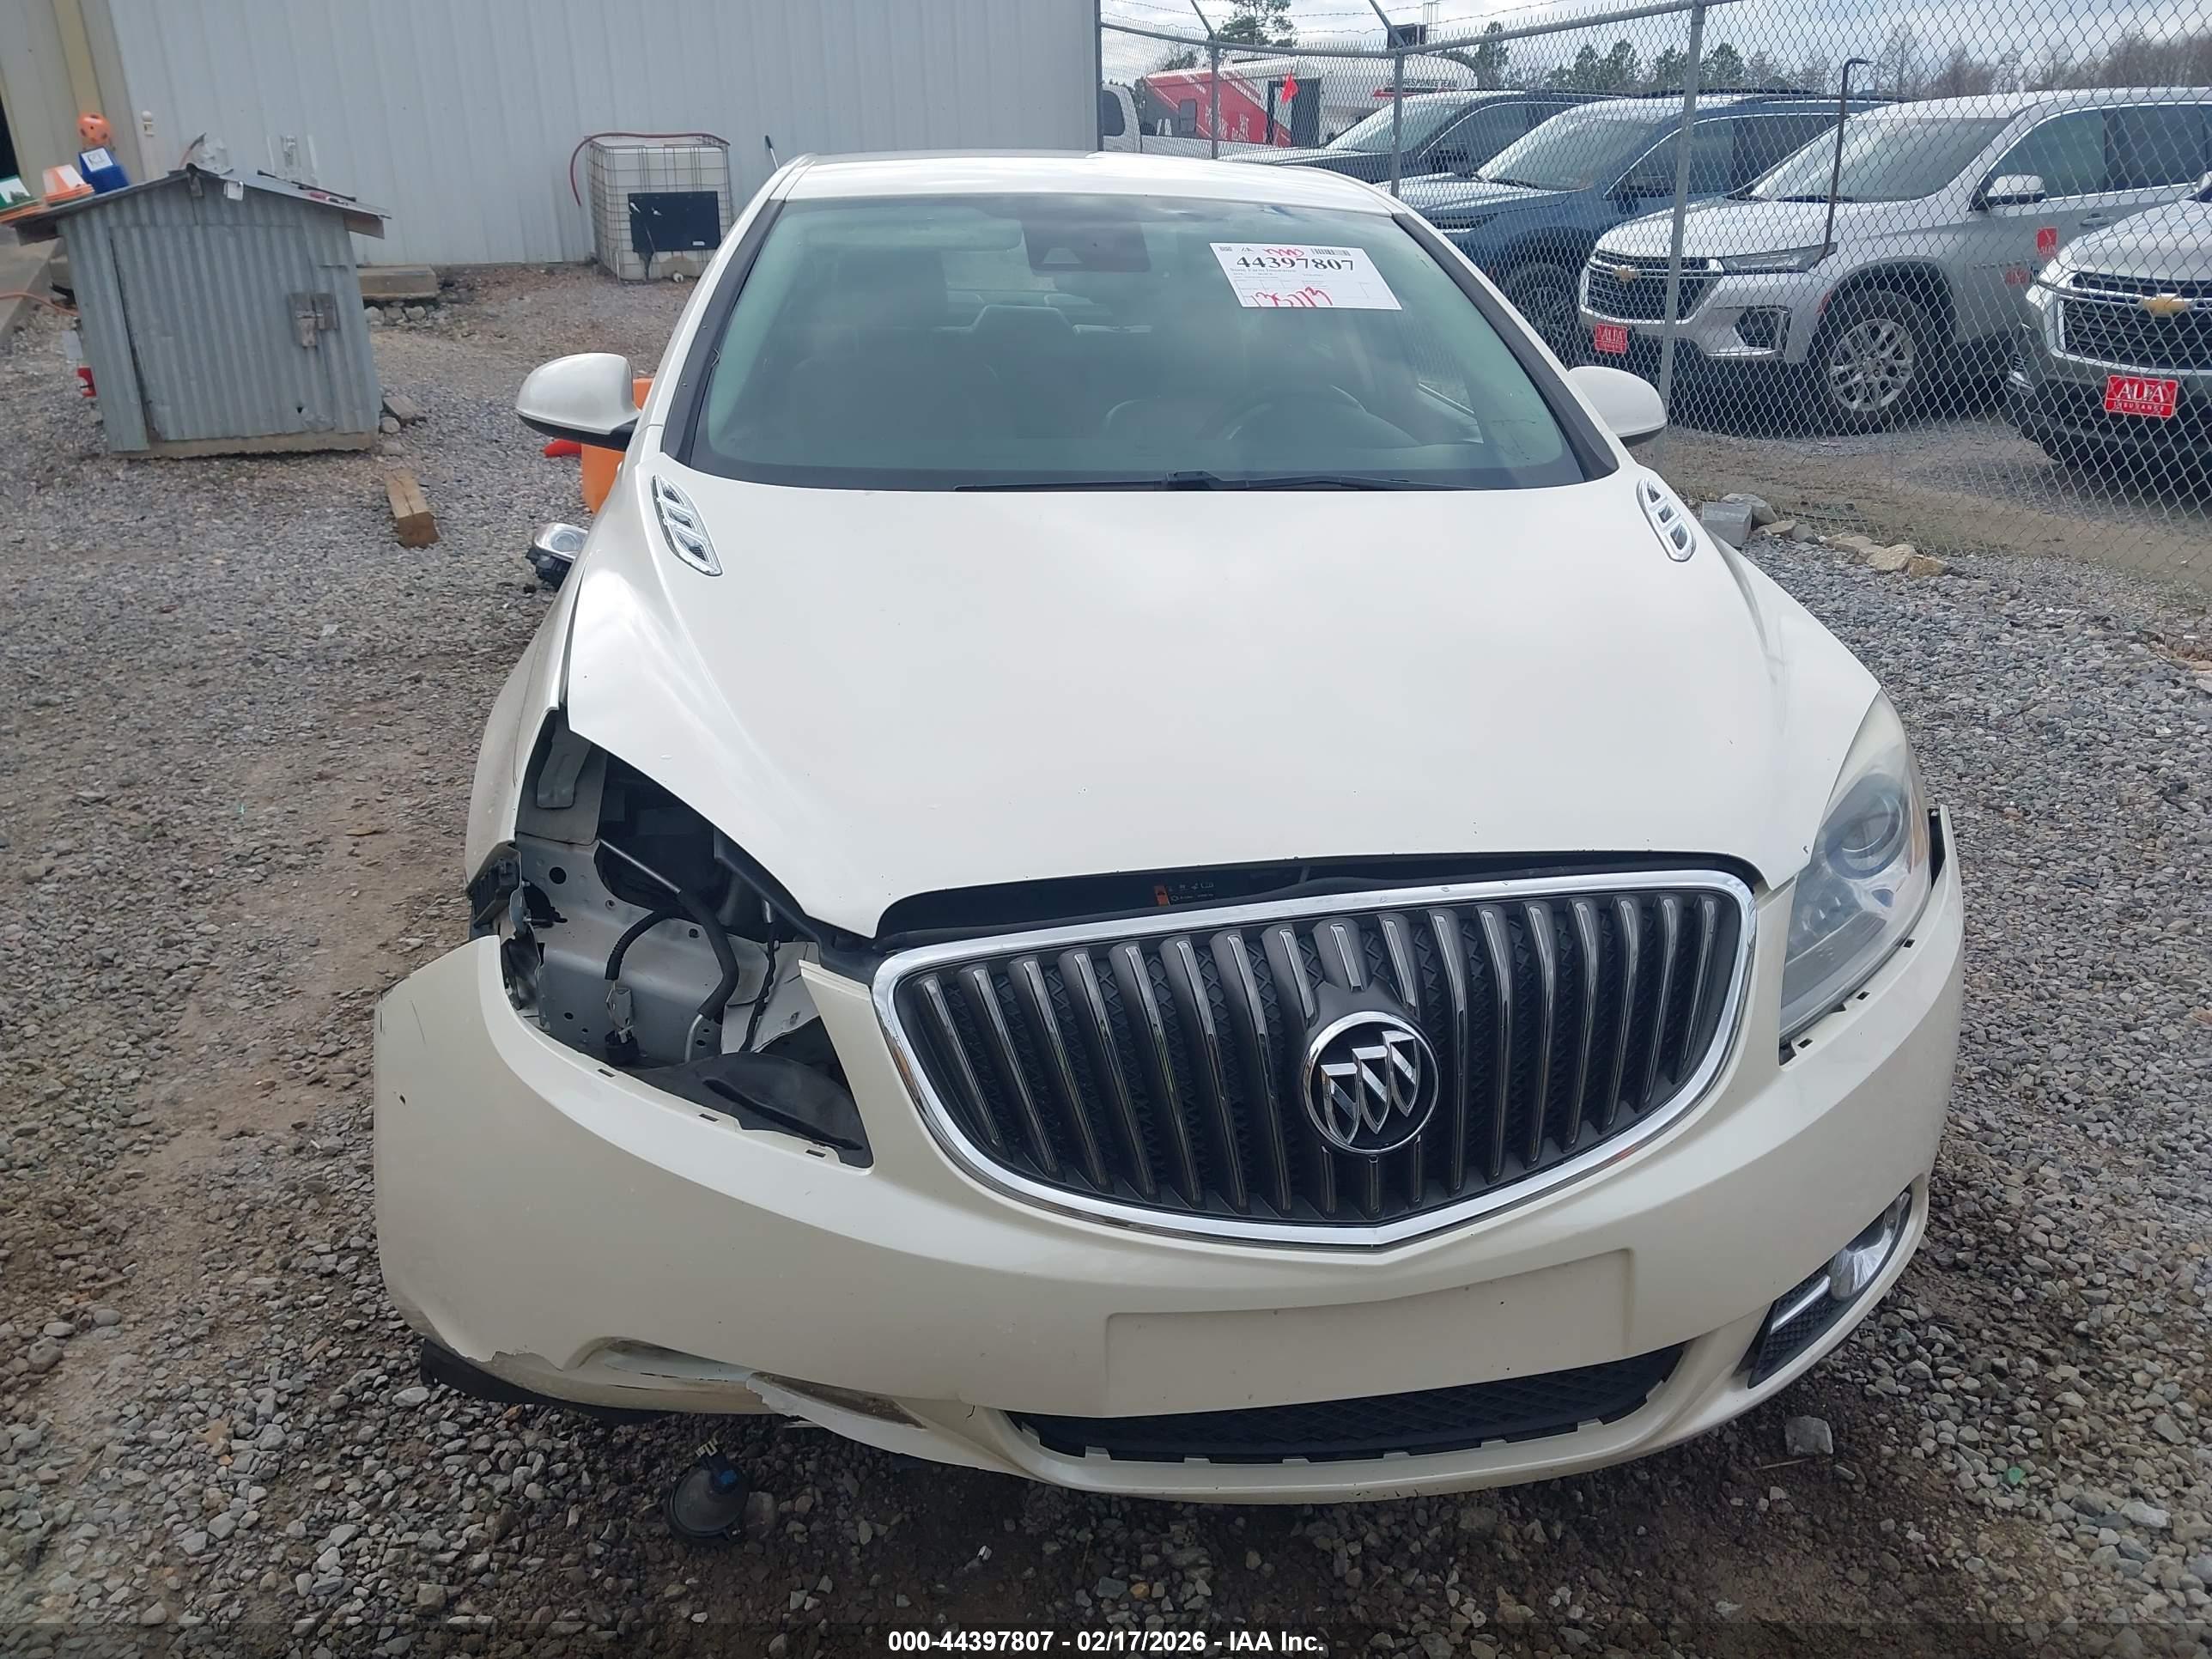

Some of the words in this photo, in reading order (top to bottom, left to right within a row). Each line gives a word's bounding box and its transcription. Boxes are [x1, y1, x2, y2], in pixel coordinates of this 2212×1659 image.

[1402, 78, 1439, 87] RESPONSE
[1441, 79, 1458, 88] TEAM
[1237, 256, 1354, 271] 44397807
[2117, 382, 2165, 403] ALFA
